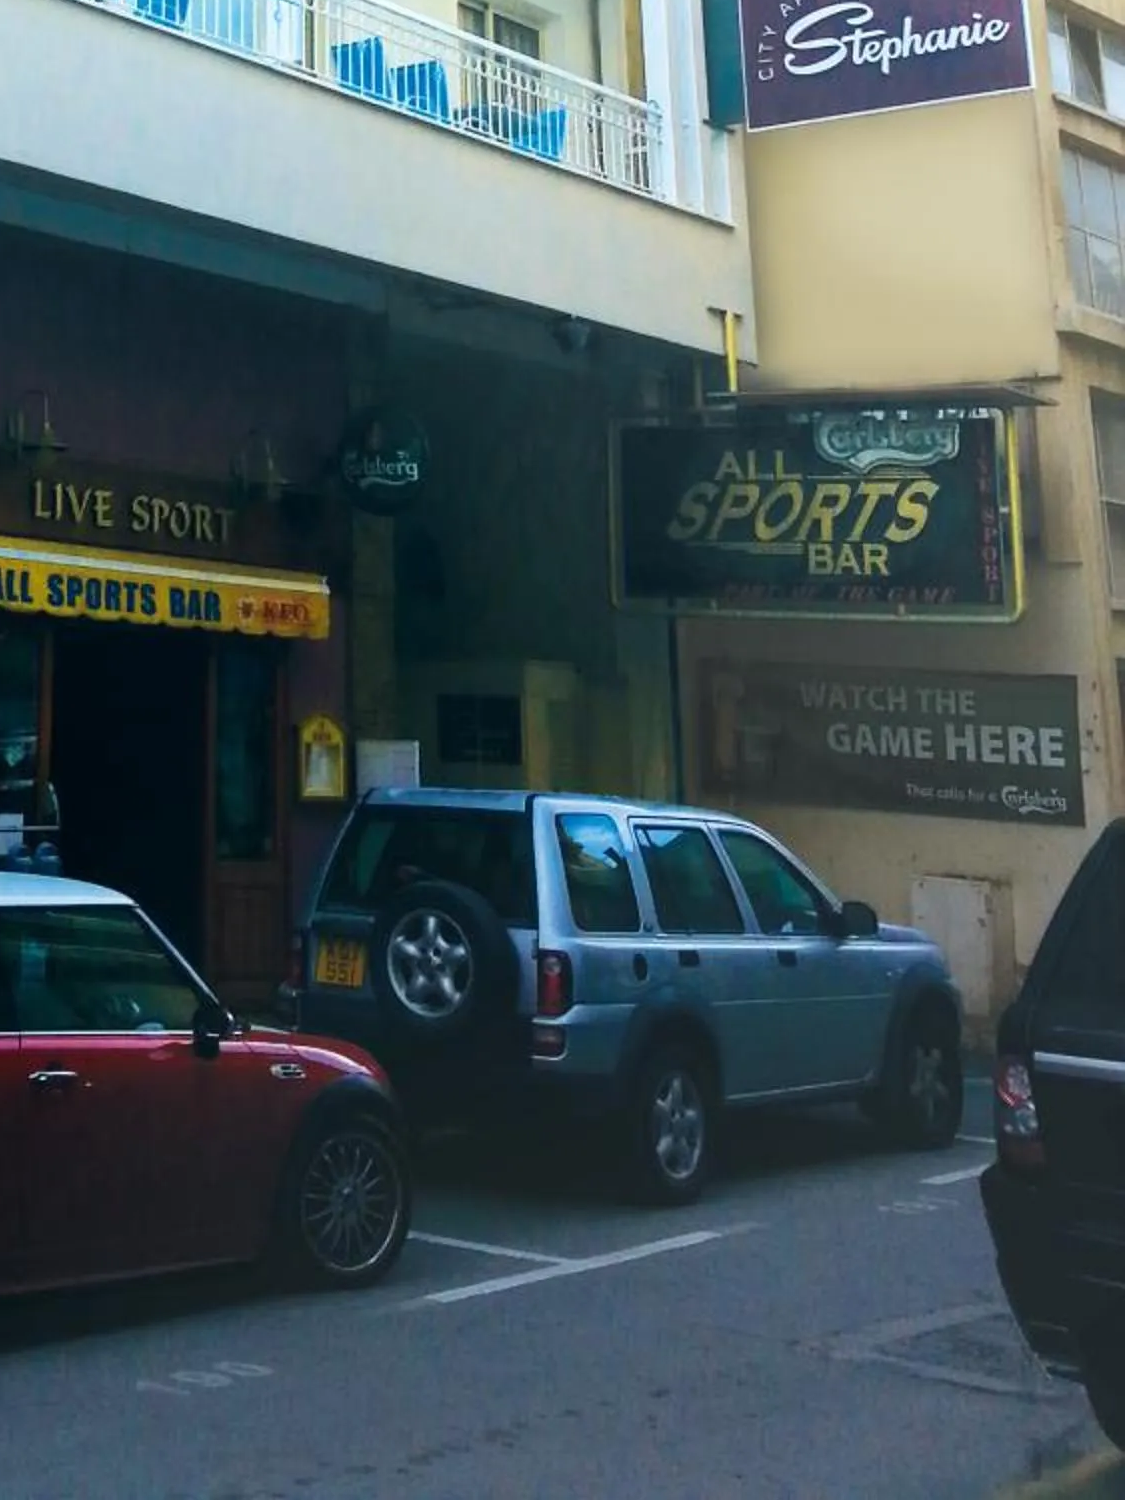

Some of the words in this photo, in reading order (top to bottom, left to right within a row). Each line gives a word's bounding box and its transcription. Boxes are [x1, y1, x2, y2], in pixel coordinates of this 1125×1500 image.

[758, 25, 777, 81] CITY
[784, 1, 1010, 75] Stephanie
[714, 449, 803, 481] ALL
[34, 479, 115, 528] LIVE
[131, 495, 235, 544] SPORT
[667, 481, 941, 543] SPORTS
[810, 543, 891, 577] BAR
[46, 574, 156, 617] SPORTS
[169, 587, 222, 623] BAR
[800, 682, 908, 714] WATCH
[916, 689, 976, 717] THE
[827, 723, 935, 759] GAME
[944, 725, 1066, 768] HERE
